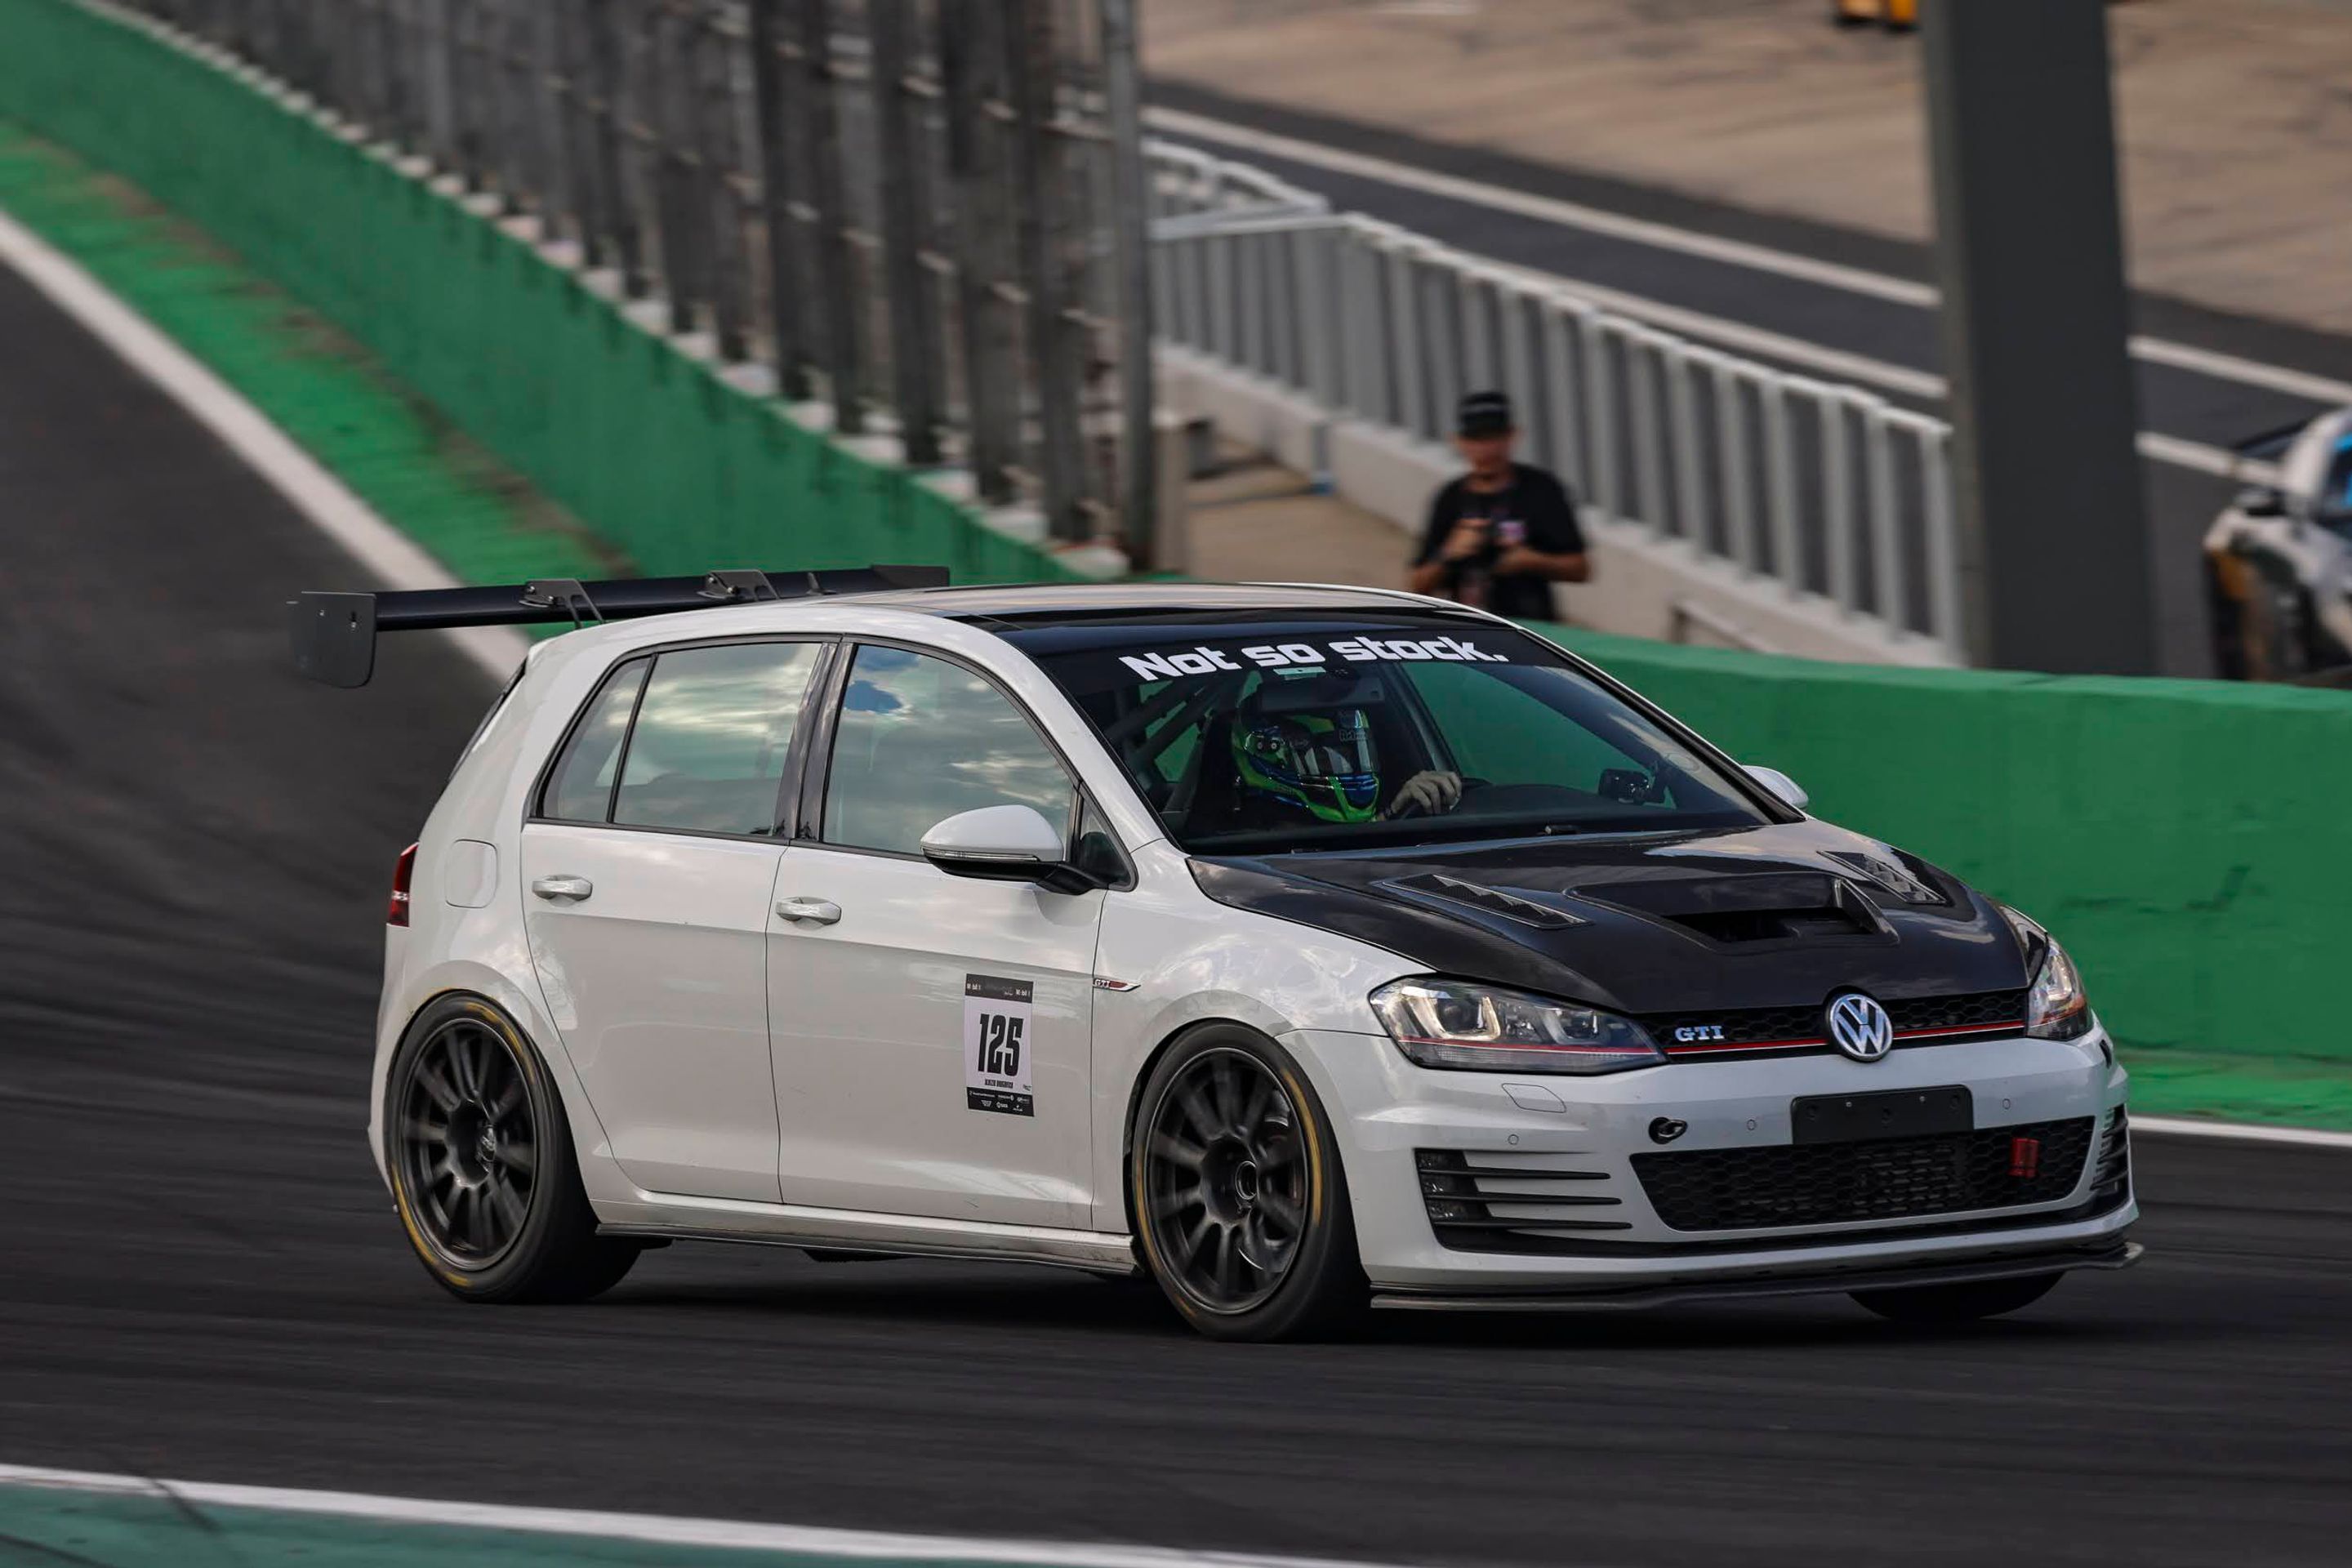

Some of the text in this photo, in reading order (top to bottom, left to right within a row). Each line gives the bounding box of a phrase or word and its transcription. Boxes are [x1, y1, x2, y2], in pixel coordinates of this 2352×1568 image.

[1119, 647, 1242, 681] Not
[1328, 636, 1509, 662] stock.
[978, 1013, 1024, 1077] 125
[1675, 1025, 1725, 1042] GTI
